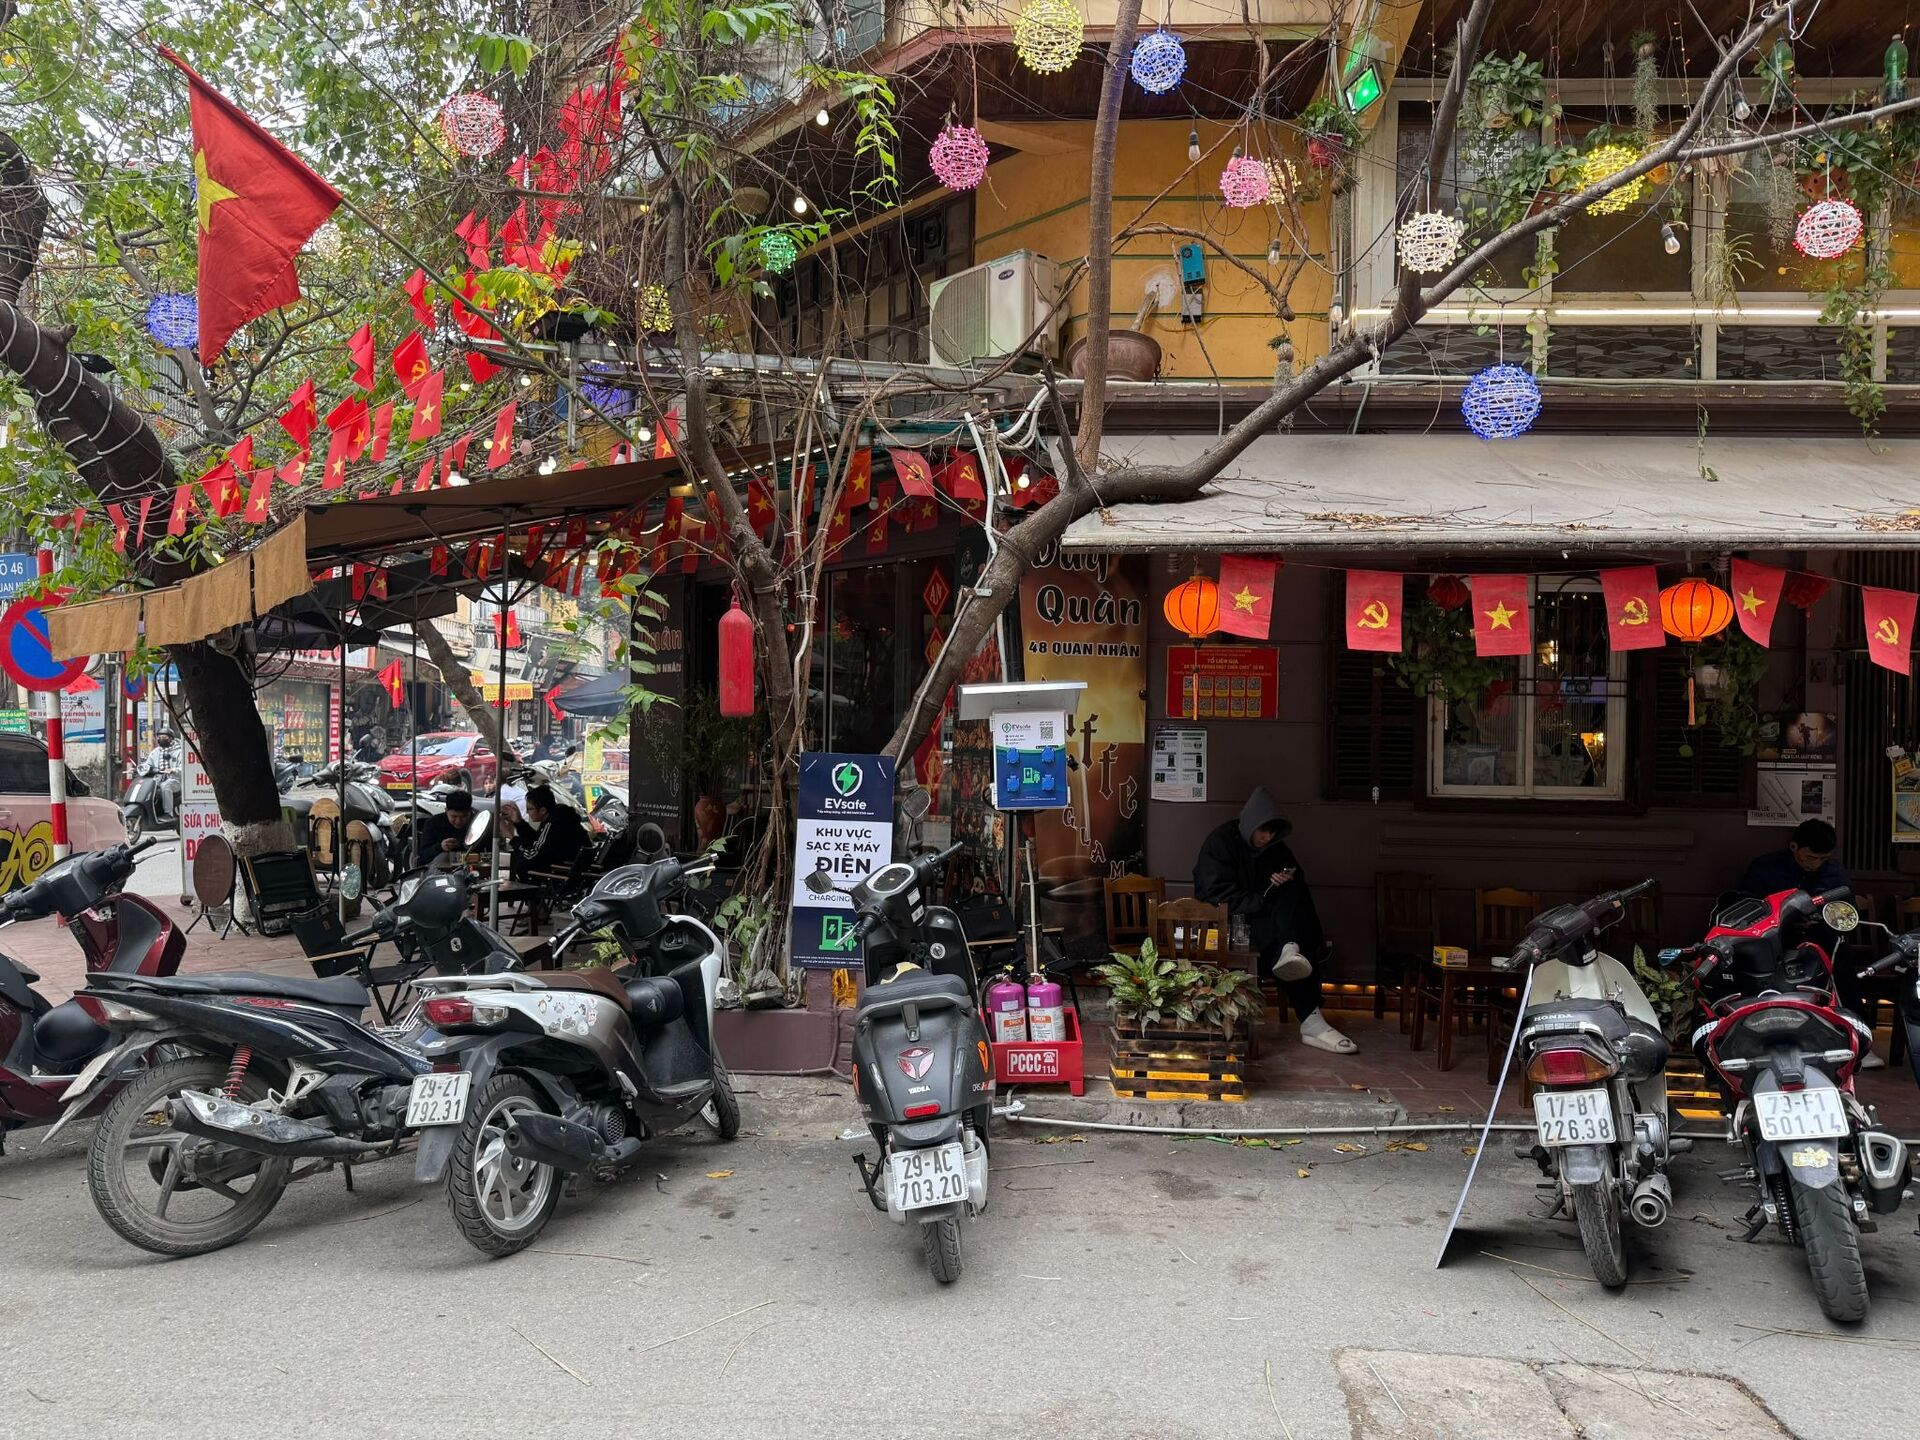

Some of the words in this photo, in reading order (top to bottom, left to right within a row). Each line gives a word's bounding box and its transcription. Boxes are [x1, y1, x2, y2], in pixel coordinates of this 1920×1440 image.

[10, 561, 24, 575] 46
[1036, 584, 1140, 627] Quân
[1028, 640, 1047, 654] 48
[1052, 640, 1093, 656] QUAN
[1097, 642, 1140, 657] NHÂN
[824, 798, 867, 810] EVsafe
[184, 809, 202, 829] SỬA
[816, 828, 842, 837] KHU
[846, 828, 872, 841] VỰC
[806, 841, 831, 853] SẠC
[834, 842, 850, 852] XE
[853, 842, 880, 853] MÁY
[815, 853, 871, 878] ĐIỆN
[808, 894, 850, 902] CHARGING
[1534, 1013, 1574, 1022] HONDA
[1010, 1053, 1042, 1073] PCCC
[1042, 1065, 1056, 1074] 114
[419, 1076, 460, 1099] 29-Z1
[410, 1099, 461, 1123] 792.31
[1546, 1093, 1597, 1118] 17-B1
[1542, 1118, 1610, 1142] 226.38
[1764, 1113, 1841, 1136] 501.14
[902, 1150, 953, 1180] 29-AC
[900, 1173, 963, 1206] 703.20
